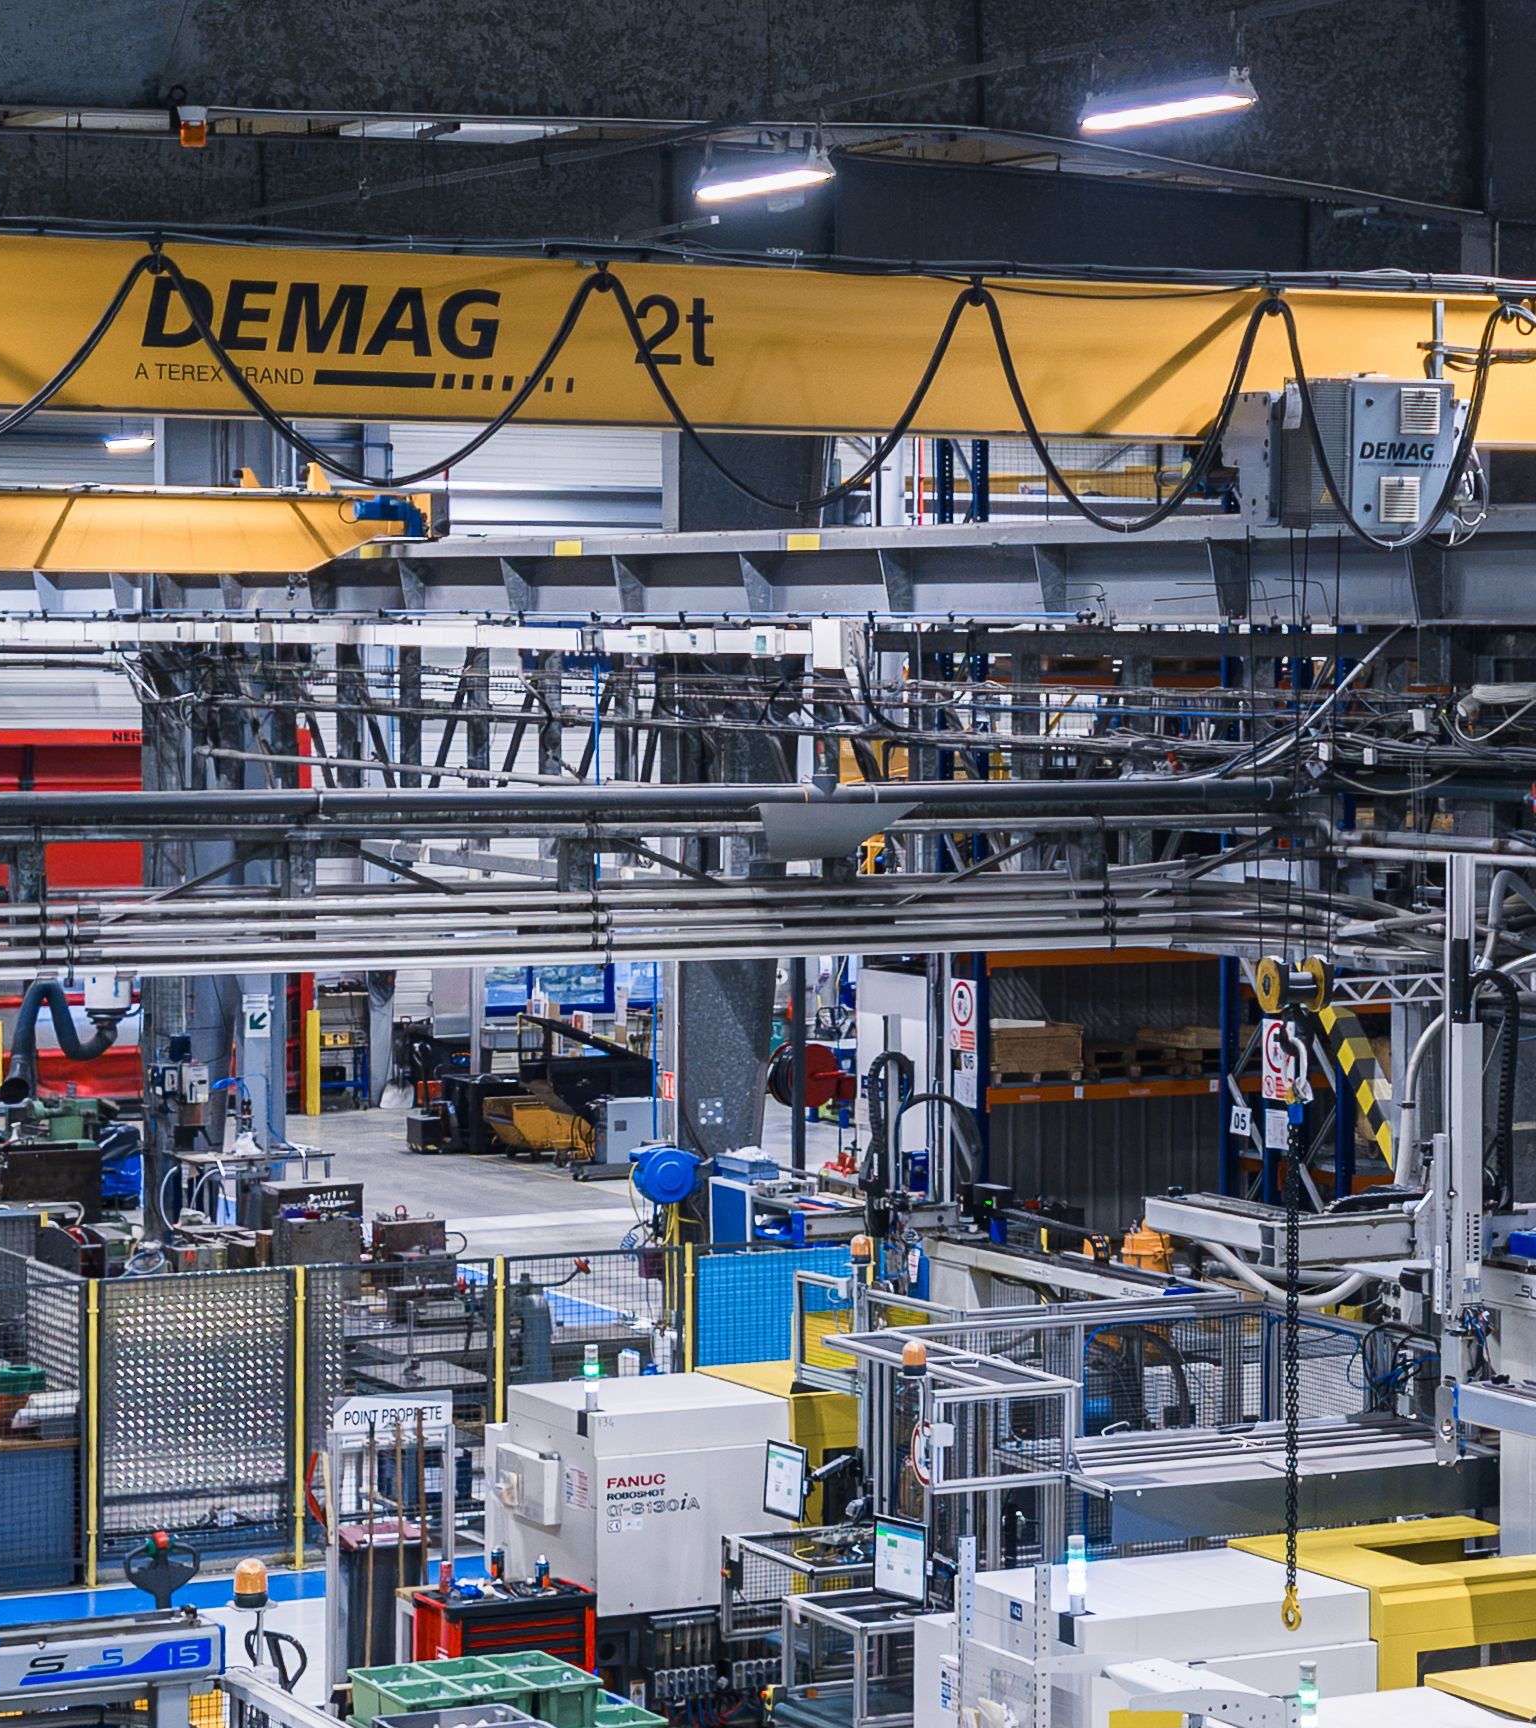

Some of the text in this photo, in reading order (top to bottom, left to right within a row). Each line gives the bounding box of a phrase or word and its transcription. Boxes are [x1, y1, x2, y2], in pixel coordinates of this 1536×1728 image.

[142, 276, 501, 359] DEMAG
[634, 293, 714, 366] 2t
[135, 362, 304, 384] A TEREX RAND
[1359, 442, 1435, 461] DEMAG
[1234, 1112, 1247, 1131] 05
[344, 1410, 378, 1426] POINT
[607, 1473, 666, 1489] FANUC
[606, 1488, 666, 1501] ROBOSHOT
[168, 1645, 201, 1666] 15
